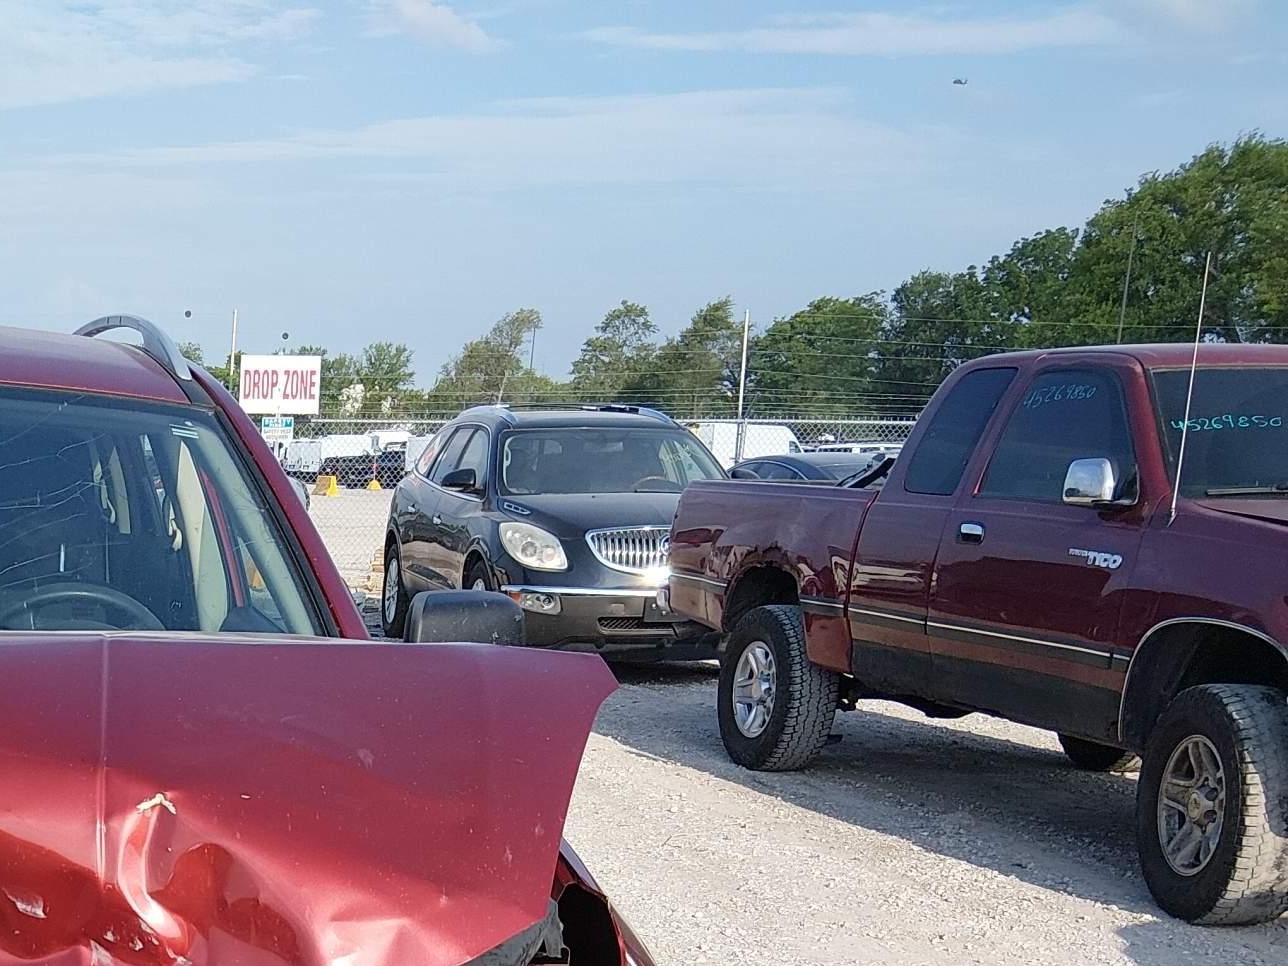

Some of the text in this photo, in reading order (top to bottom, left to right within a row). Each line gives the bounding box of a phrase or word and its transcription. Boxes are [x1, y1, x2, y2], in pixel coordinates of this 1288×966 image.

[243, 370, 317, 400] DROP ZONE
[1170, 413, 1283, 432] 45269850
